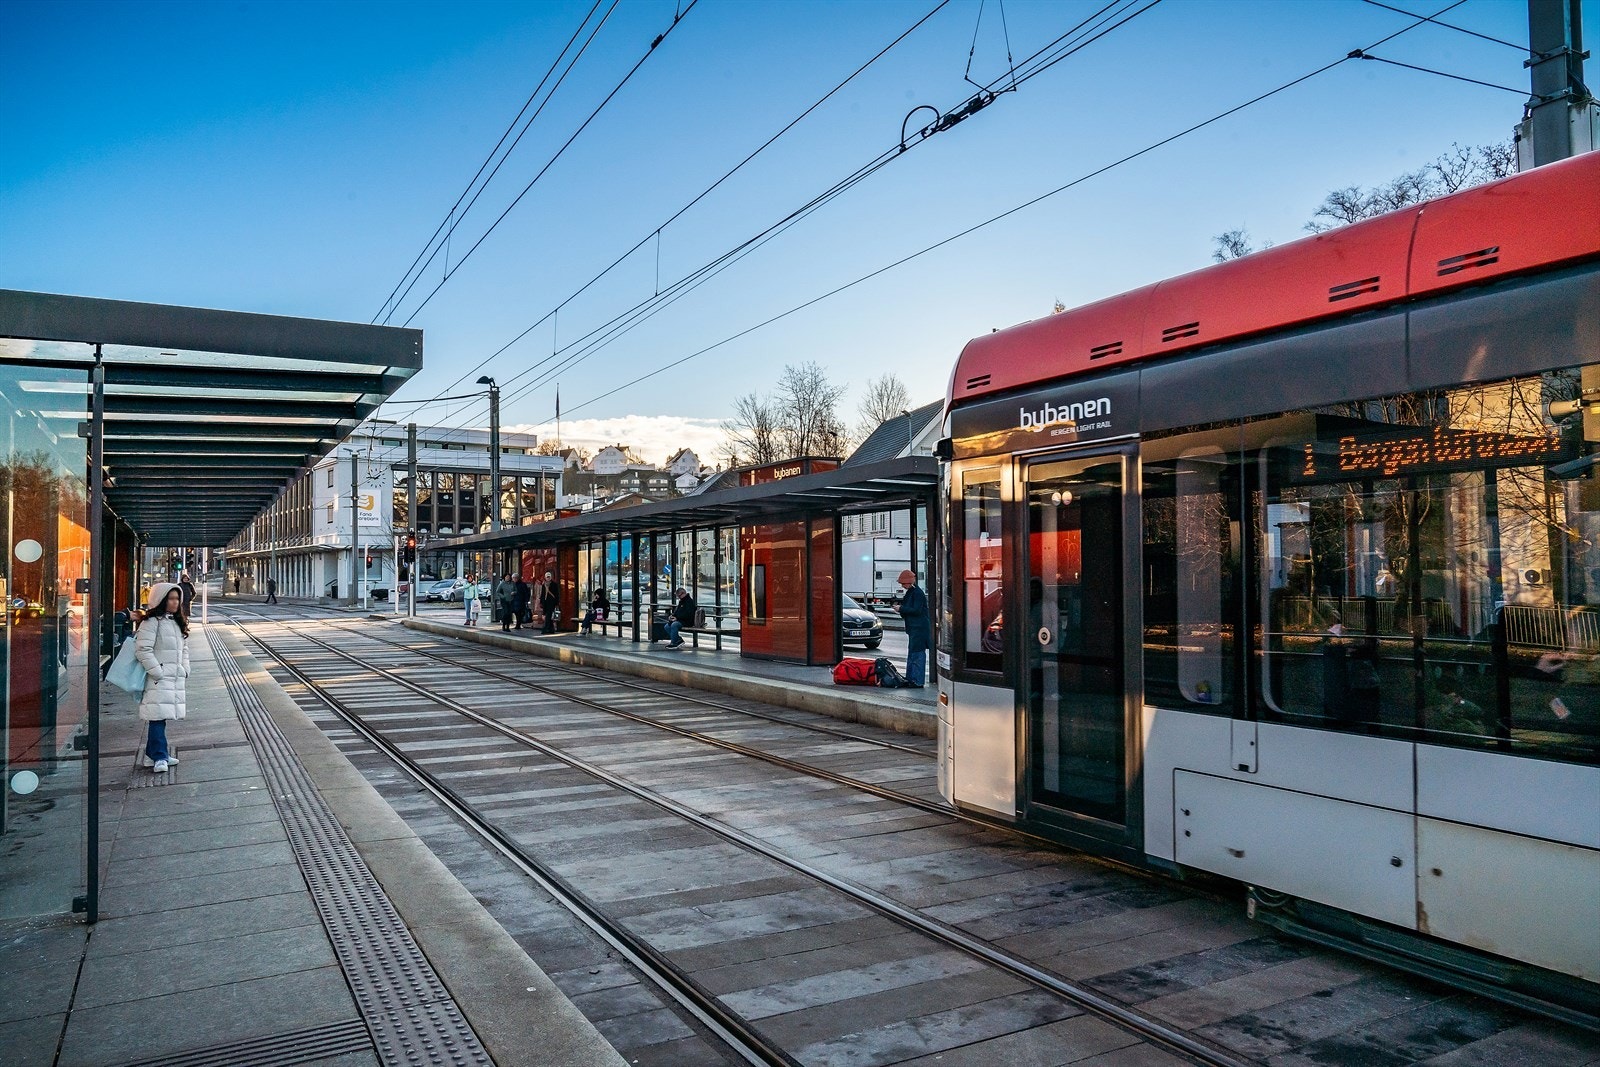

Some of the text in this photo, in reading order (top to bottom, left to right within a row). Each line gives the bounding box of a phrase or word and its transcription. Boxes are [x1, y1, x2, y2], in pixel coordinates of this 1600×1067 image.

[1019, 397, 1111, 433] bybanen
[1051, 421, 1112, 437] BERGEN LIGHT RAIL
[774, 466, 801, 480] bybanen
